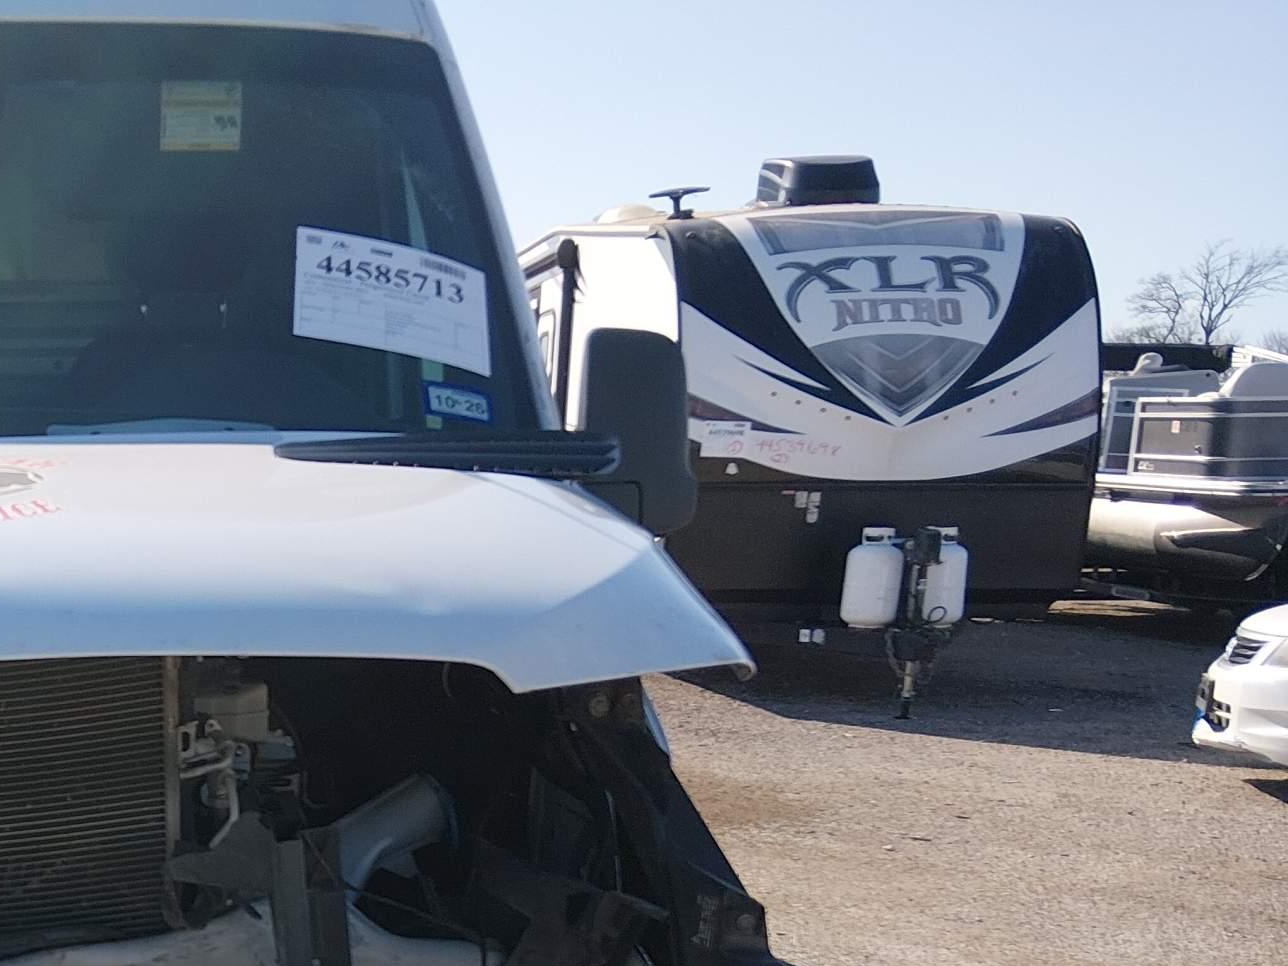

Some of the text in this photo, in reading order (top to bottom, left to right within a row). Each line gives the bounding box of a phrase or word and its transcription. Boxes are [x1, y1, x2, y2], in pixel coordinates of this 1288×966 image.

[316, 255, 465, 305] 44585713
[777, 254, 1001, 324] XLR
[831, 297, 963, 331] NITRO
